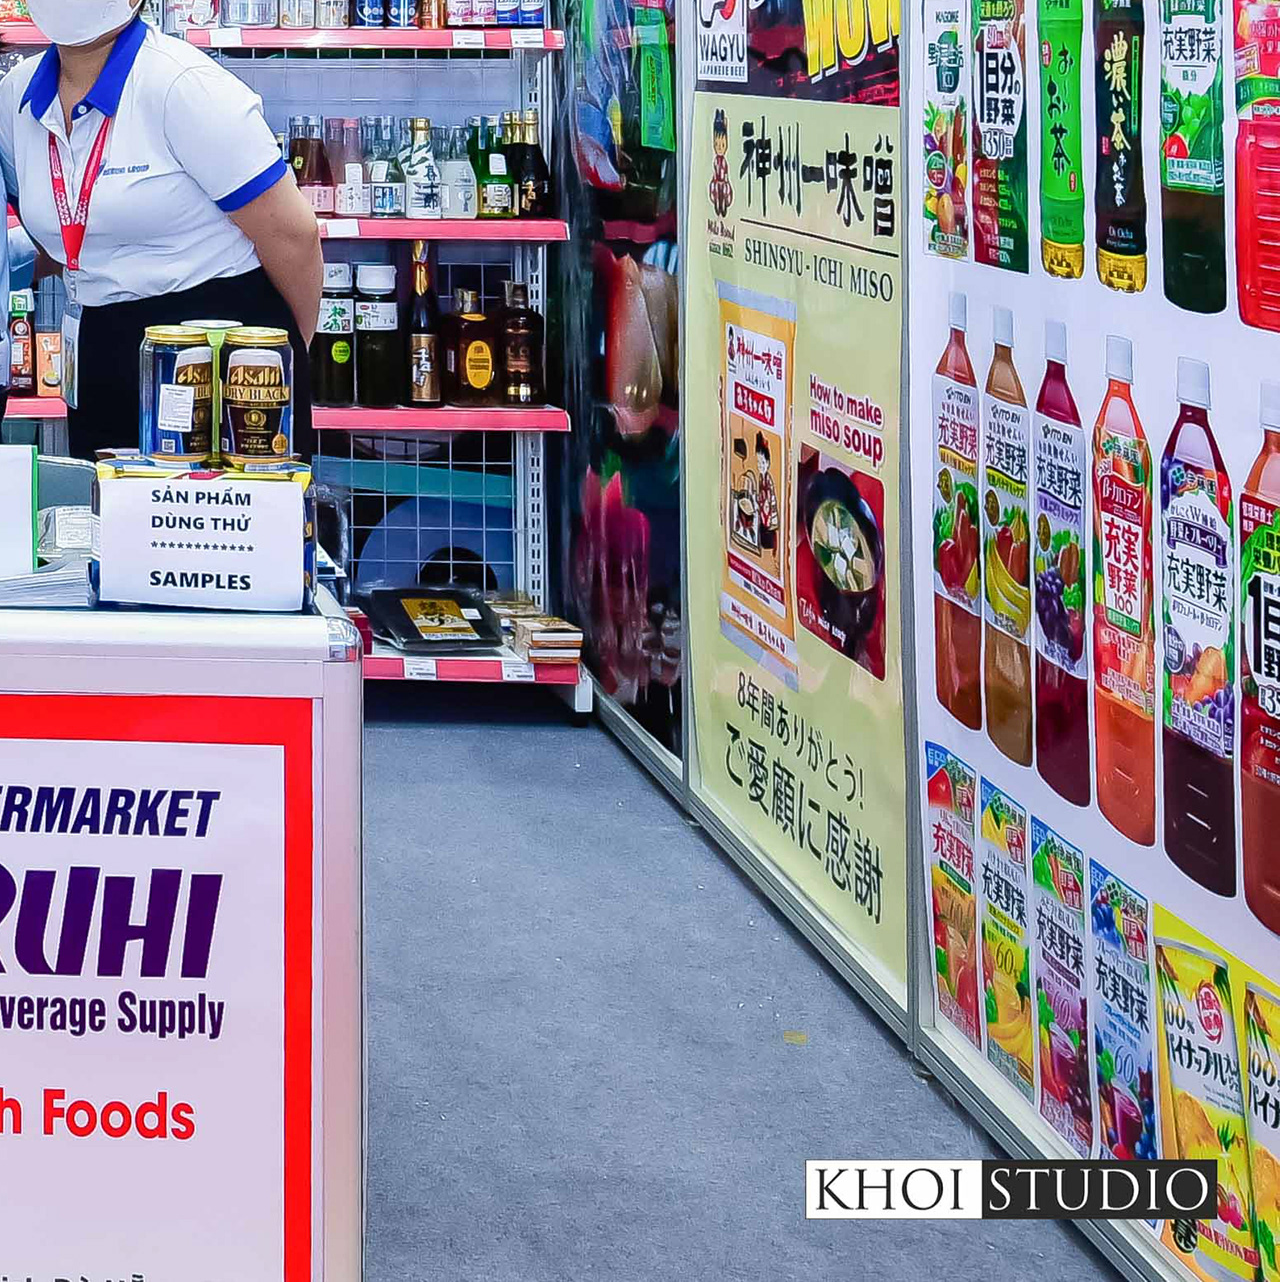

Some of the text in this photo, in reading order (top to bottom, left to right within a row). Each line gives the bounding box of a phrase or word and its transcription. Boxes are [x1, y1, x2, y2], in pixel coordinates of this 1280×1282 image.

[700, 33, 745, 62] WAGYU
[1162, 27, 1217, 64] 充実野菜
[738, 119, 896, 240] 神州一味噌
[850, 264, 894, 302] MISO
[230, 366, 280, 386] Asahi
[249, 387, 287, 400] BLACK
[810, 374, 831, 406] How
[833, 382, 844, 409] to
[846, 392, 882, 426] make
[810, 407, 883, 467] miso soup
[151, 485, 251, 507] SẢN PHẨM
[1036, 454, 1083, 507] 充実野菜
[151, 512, 251, 533] DÙNG THỬ
[1105, 519, 1140, 571] 充実
[149, 569, 251, 592] SAMPLES
[1107, 560, 1138, 600] 野菜
[1166, 551, 1228, 614] 充実野菜
[1114, 592, 1134, 614] 100
[726, 722, 883, 925] ご愛顧に感謝
[117, 989, 225, 1040] Supply
[1094, 953, 1151, 1035] 充実野菜
[44, 1089, 196, 1142] Foods
